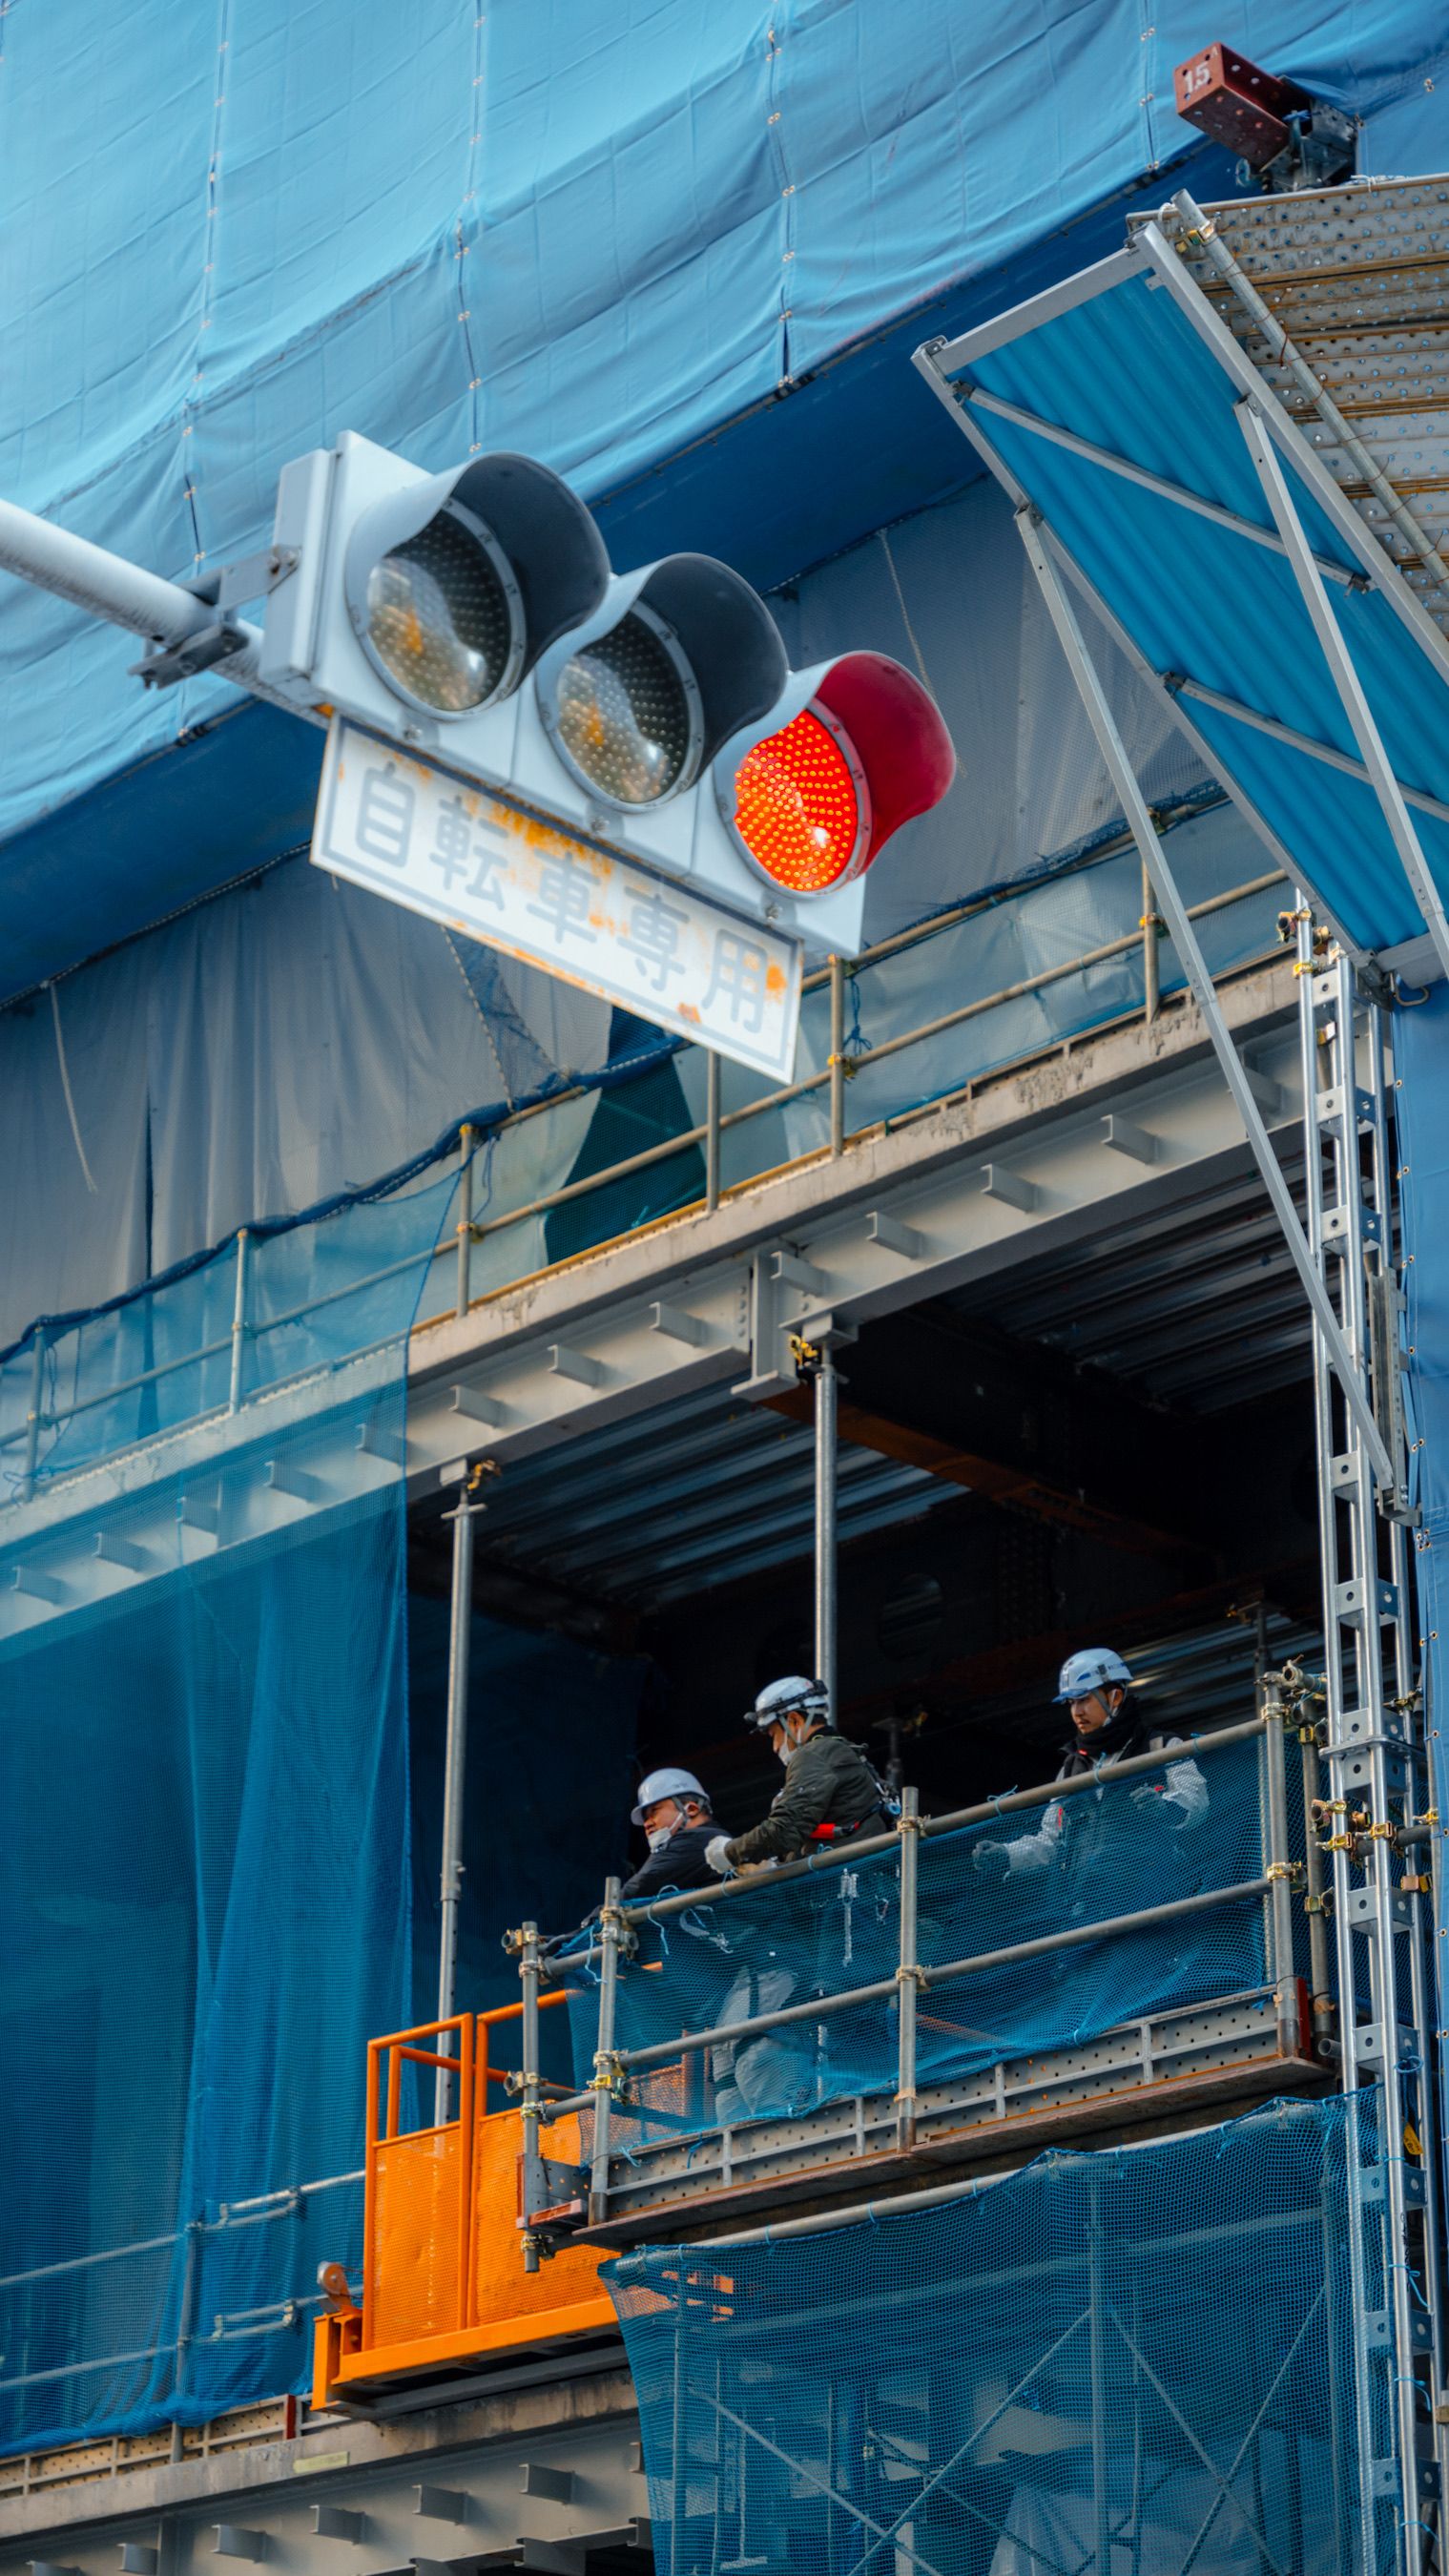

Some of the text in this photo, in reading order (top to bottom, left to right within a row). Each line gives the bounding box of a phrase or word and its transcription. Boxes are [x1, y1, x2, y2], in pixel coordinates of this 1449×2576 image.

[356, 761, 766, 1032] 自転車専用
